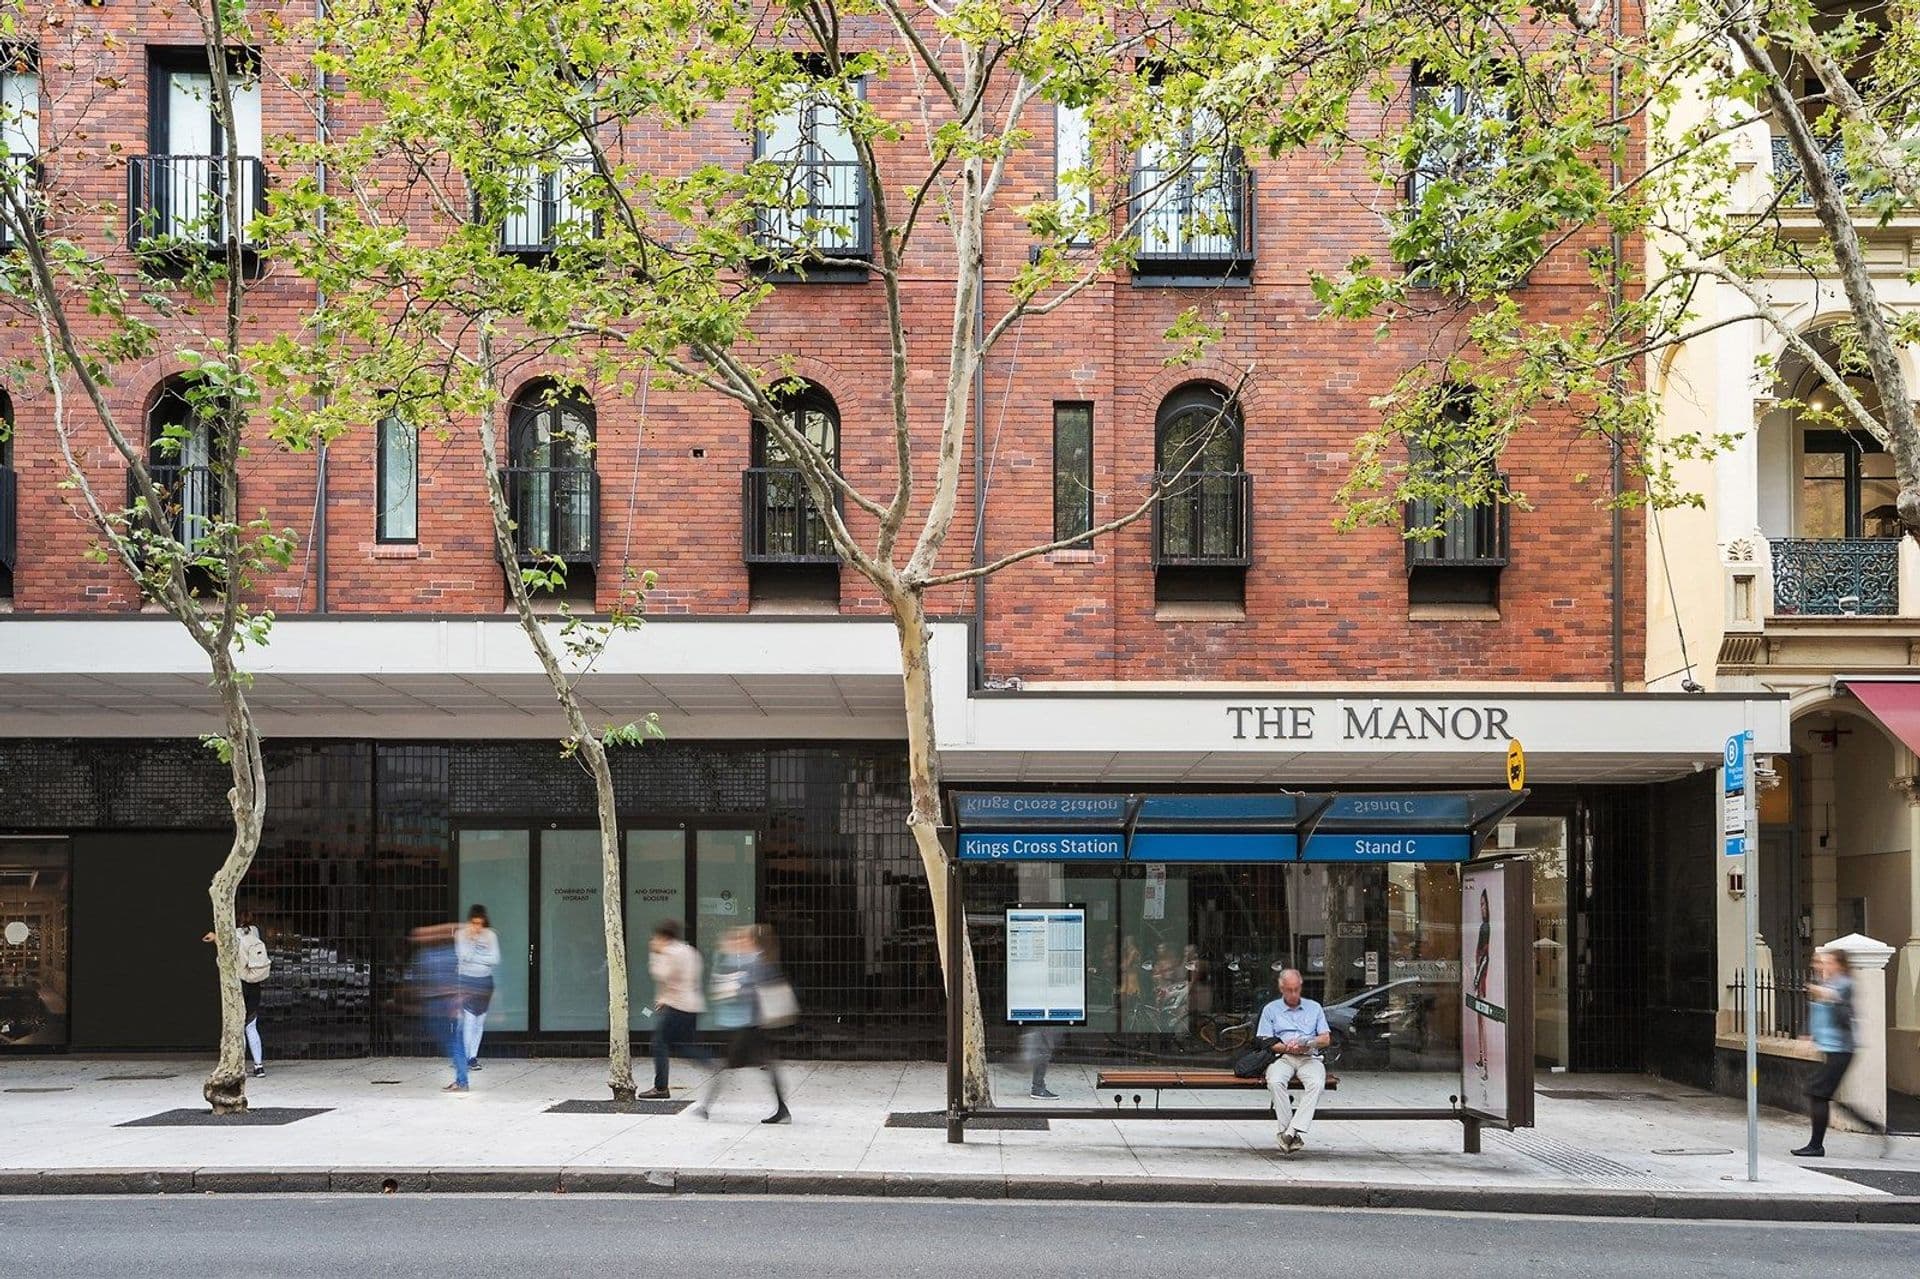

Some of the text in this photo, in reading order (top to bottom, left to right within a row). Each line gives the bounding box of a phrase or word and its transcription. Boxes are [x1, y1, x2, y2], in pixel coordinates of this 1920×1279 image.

[1226, 706, 1514, 740] THE MANOR
[966, 838, 1118, 858] Kings Cross Station
[1354, 839, 1417, 854] Stand C
